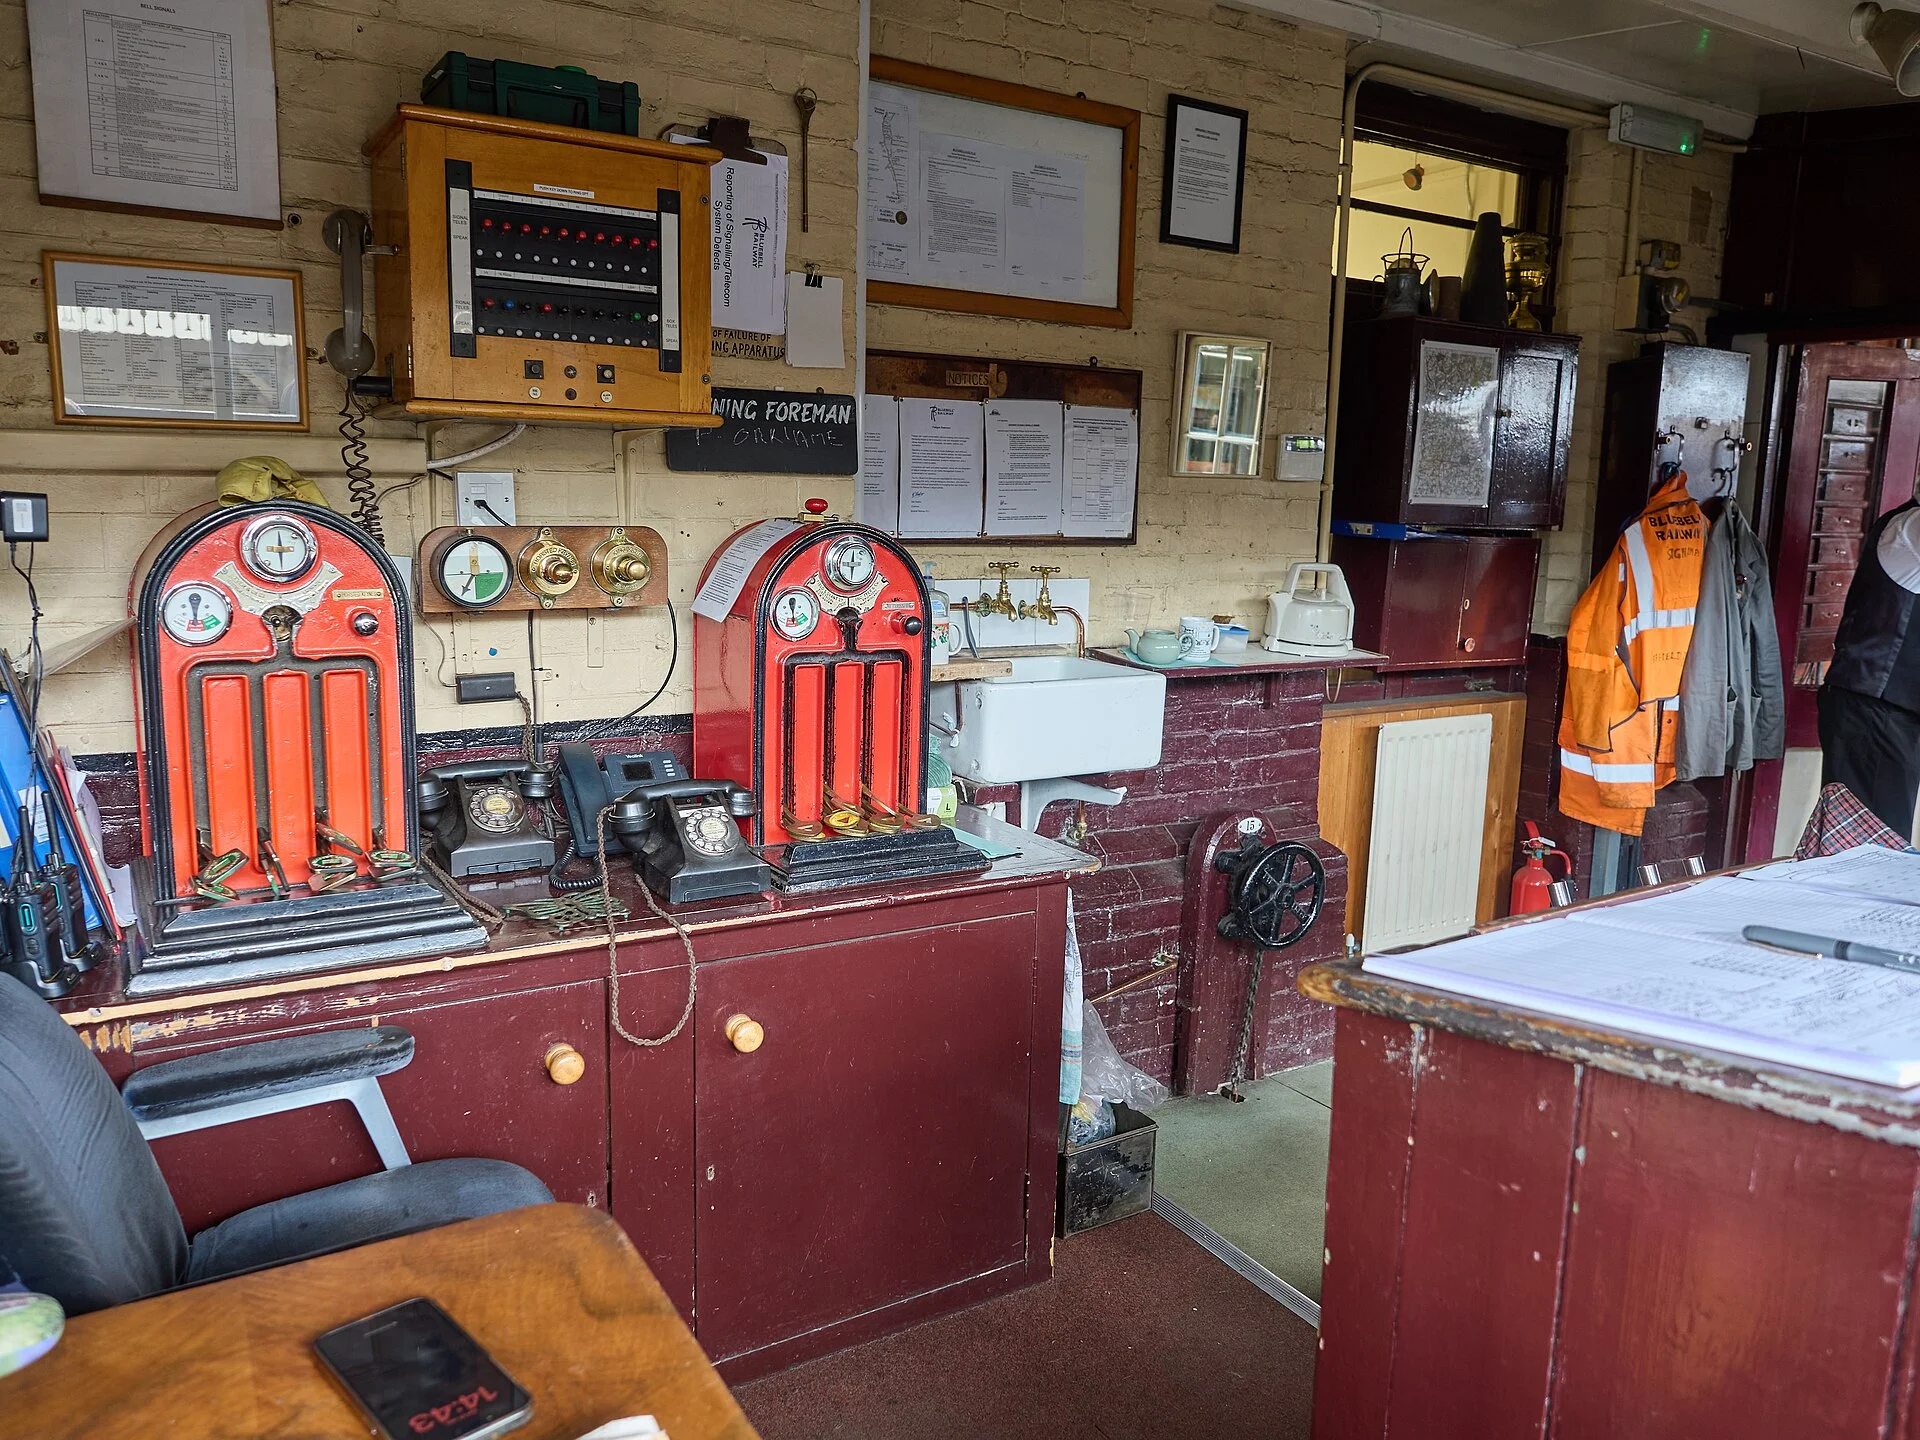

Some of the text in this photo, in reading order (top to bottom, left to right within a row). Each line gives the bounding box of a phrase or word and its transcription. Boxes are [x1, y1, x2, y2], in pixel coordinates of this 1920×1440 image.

[154, 5, 176, 14] SIGNALS
[713, 200, 723, 271] System Defects
[723, 167, 735, 307] Reporting of Signalling/Telecom
[713, 329, 772, 342] OF FAILURE OF
[732, 343, 785, 358] APPARATUS
[948, 372, 989, 386] NOTICES
[765, 401, 851, 424] FOREMAN
[1246, 820, 1255, 831] 15
[408, 1385, 499, 1434] 14:43
